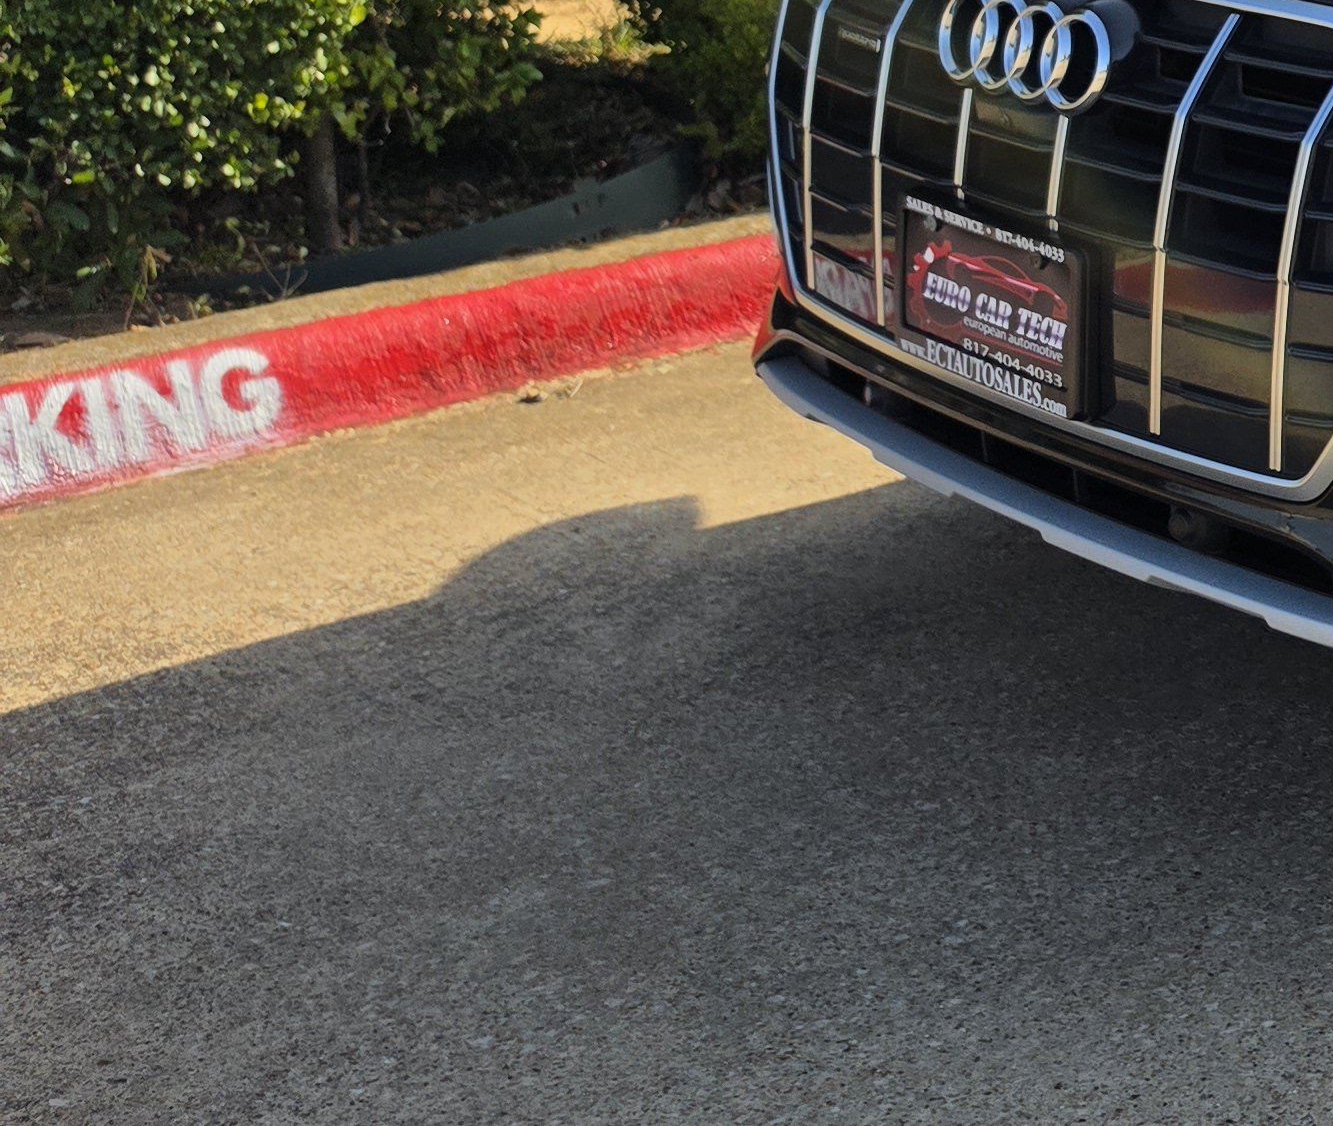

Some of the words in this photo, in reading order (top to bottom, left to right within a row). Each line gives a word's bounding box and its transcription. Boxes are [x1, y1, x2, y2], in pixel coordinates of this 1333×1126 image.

[905, 195, 933, 217] SALES
[943, 207, 985, 236] SERVICE
[994, 227, 1065, 263] 817-404-4033
[923, 272, 971, 313] EURO
[975, 292, 1013, 330] CAR
[1018, 307, 1068, 351] TECH
[963, 315, 1007, 342] european
[1007, 332, 1064, 363] automotive
[899, 338, 1068, 418] www.ECTAUTOSALES.com
[962, 337, 1064, 388] 817-404-4033
[0, 347, 283, 496] KING
